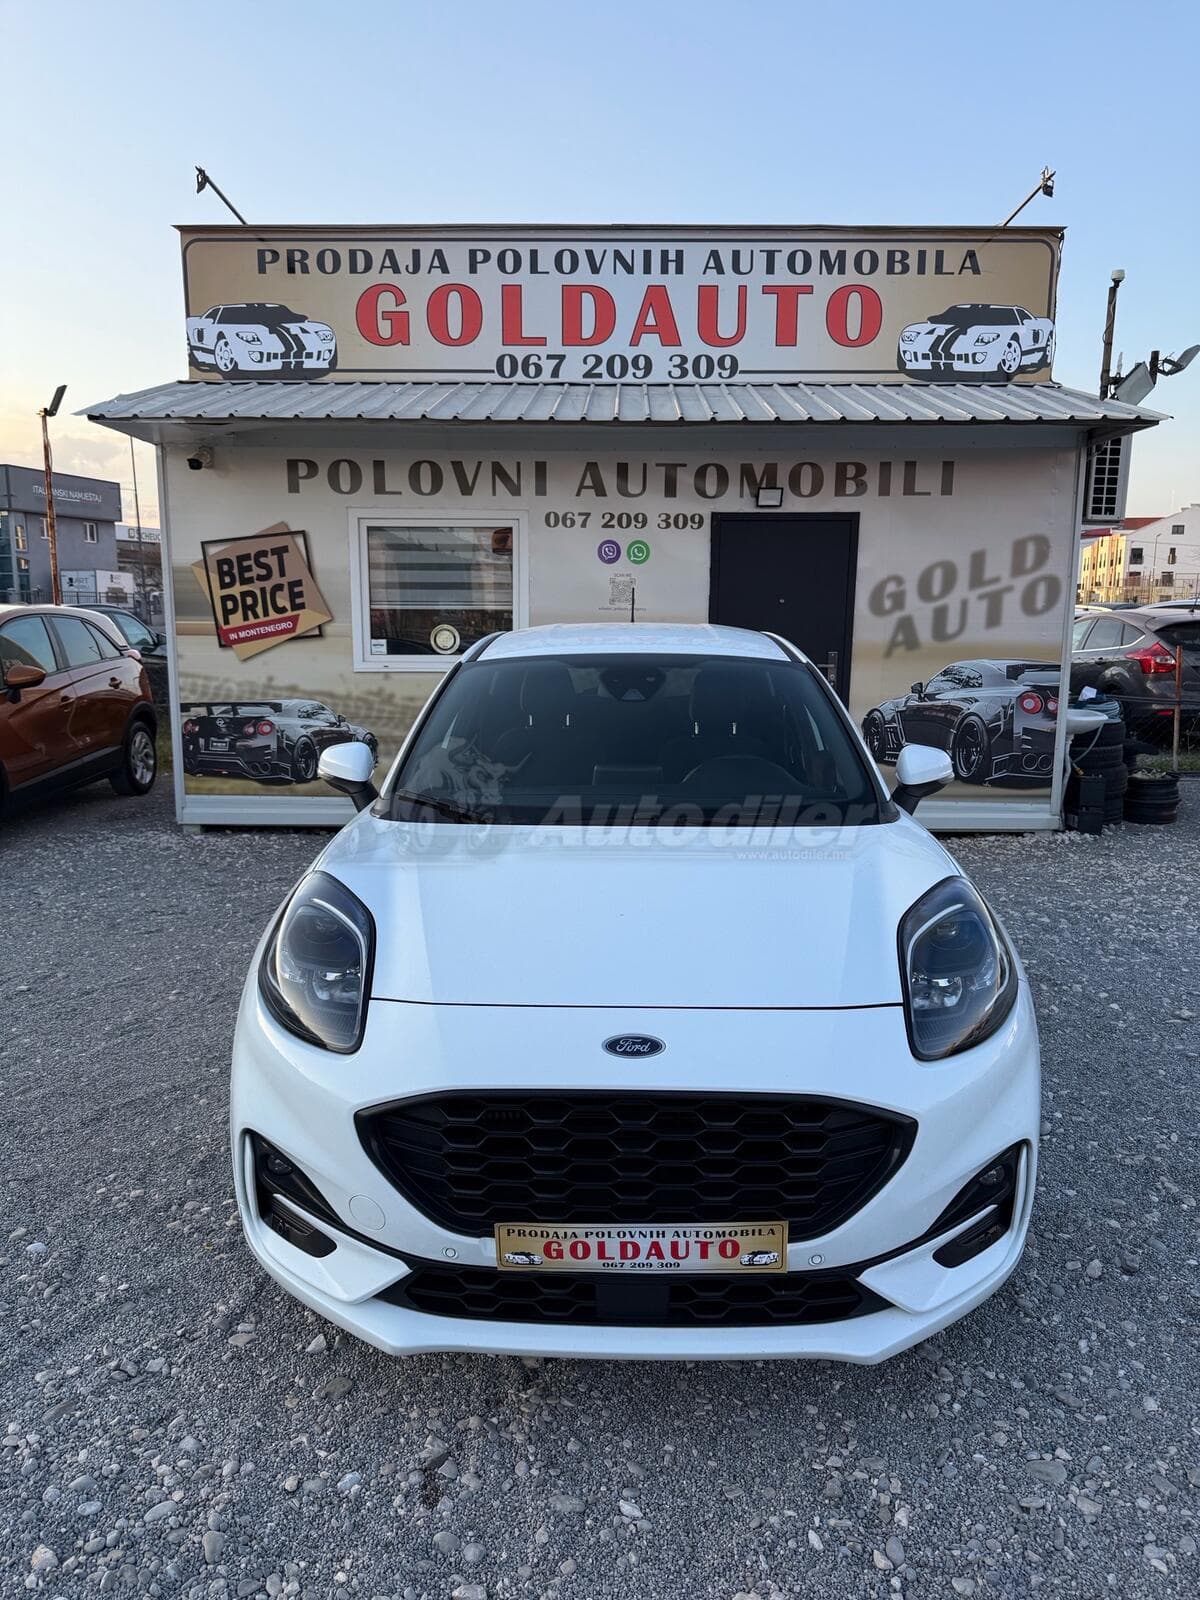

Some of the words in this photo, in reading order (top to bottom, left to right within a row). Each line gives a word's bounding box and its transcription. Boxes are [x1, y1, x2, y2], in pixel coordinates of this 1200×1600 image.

[257, 248, 450, 275] PRODAJA
[468, 248, 684, 275] POLOVNIH
[703, 249, 981, 276] AUTOMOBILA
[355, 282, 883, 348] GOLDAUTO
[495, 353, 567, 380] 067
[582, 353, 653, 380] 209
[668, 353, 739, 380] 309
[286, 458, 548, 496] POLOVNI
[575, 460, 955, 498] AUTOMOBILI
[544, 511, 592, 529] 067
[601, 512, 648, 530] 209
[657, 512, 705, 530] 309
[216, 545, 289, 590] BEST
[868, 533, 1050, 617] GOLD
[220, 579, 306, 626] PRICE
[883, 573, 1062, 659] AUTO
[238, 621, 293, 639] MONTENEGRO
[616, 1038, 651, 1051] Ford
[506, 1228, 578, 1239] PRODAJA
[584, 1229, 666, 1239] POLOVNIH
[672, 1227, 776, 1239] AUTOMOBILA
[543, 1239, 741, 1260] GOLDAUTO
[602, 1261, 625, 1269] 067
[630, 1261, 653, 1269] 209
[657, 1261, 681, 1269] 309
